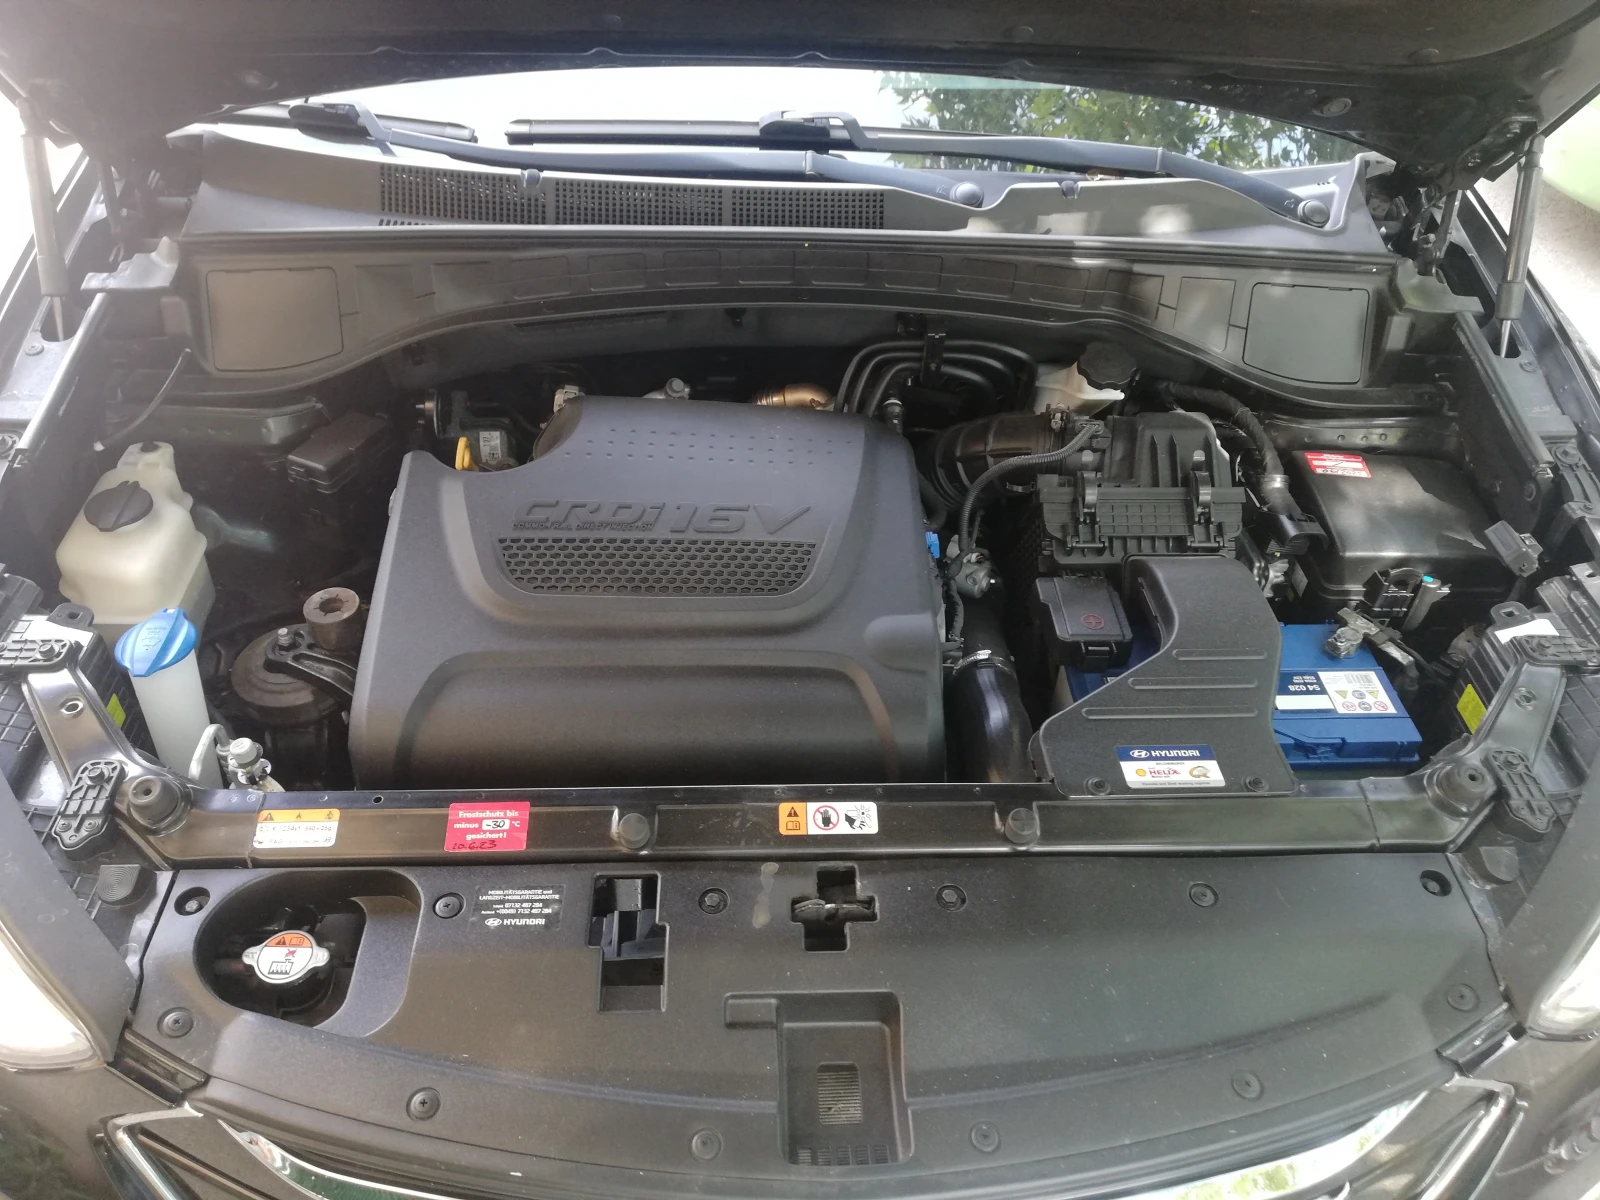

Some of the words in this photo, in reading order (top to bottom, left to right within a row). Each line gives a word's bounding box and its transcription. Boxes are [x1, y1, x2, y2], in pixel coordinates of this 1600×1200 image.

[669, 502, 811, 534] 16V
[458, 810, 505, 818] Frostschutz
[506, 809, 519, 817] bis
[511, 820, 521, 828] °C
[466, 832, 507, 841] gesichert!
